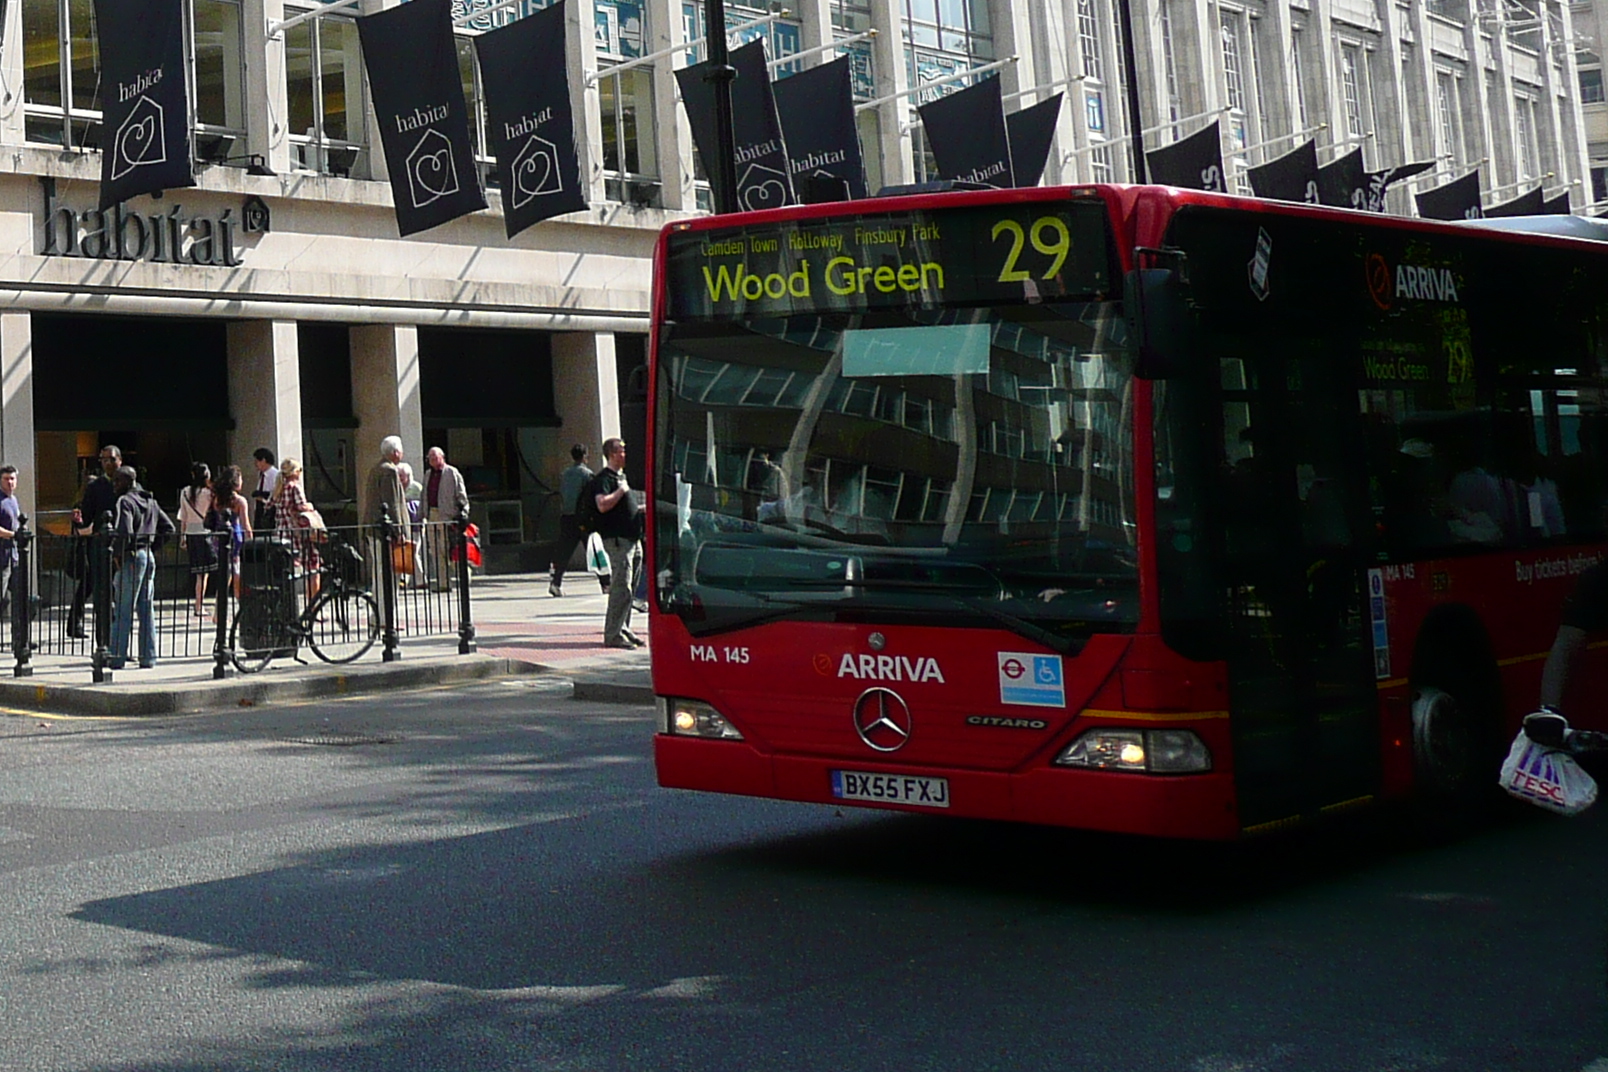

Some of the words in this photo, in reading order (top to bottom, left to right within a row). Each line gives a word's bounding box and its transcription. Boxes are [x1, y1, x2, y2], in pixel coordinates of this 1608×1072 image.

[734, 138, 779, 165] abitat
[791, 148, 846, 175] habitat
[38, 173, 244, 267] habitat
[701, 239, 744, 257] Camden
[750, 236, 779, 253] Town
[790, 231, 843, 252] Holloway
[855, 226, 906, 248] Finsbury
[913, 223, 940, 241] Park
[992, 215, 1071, 283] 29
[702, 260, 810, 302] Wood
[825, 256, 944, 296] Green
[1395, 263, 1459, 303] ARRIVA
[1362, 354, 1395, 381] Wood
[1397, 356, 1430, 382] Green
[1515, 560, 1533, 586] Buy
[690, 645, 717, 663] MA
[723, 646, 750, 664] 145
[837, 653, 945, 684] ARRIVA
[967, 715, 1045, 729] CITARO
[845, 774, 898, 799] BX55
[904, 778, 945, 803] FXJ
[1514, 768, 1565, 801] TESC
